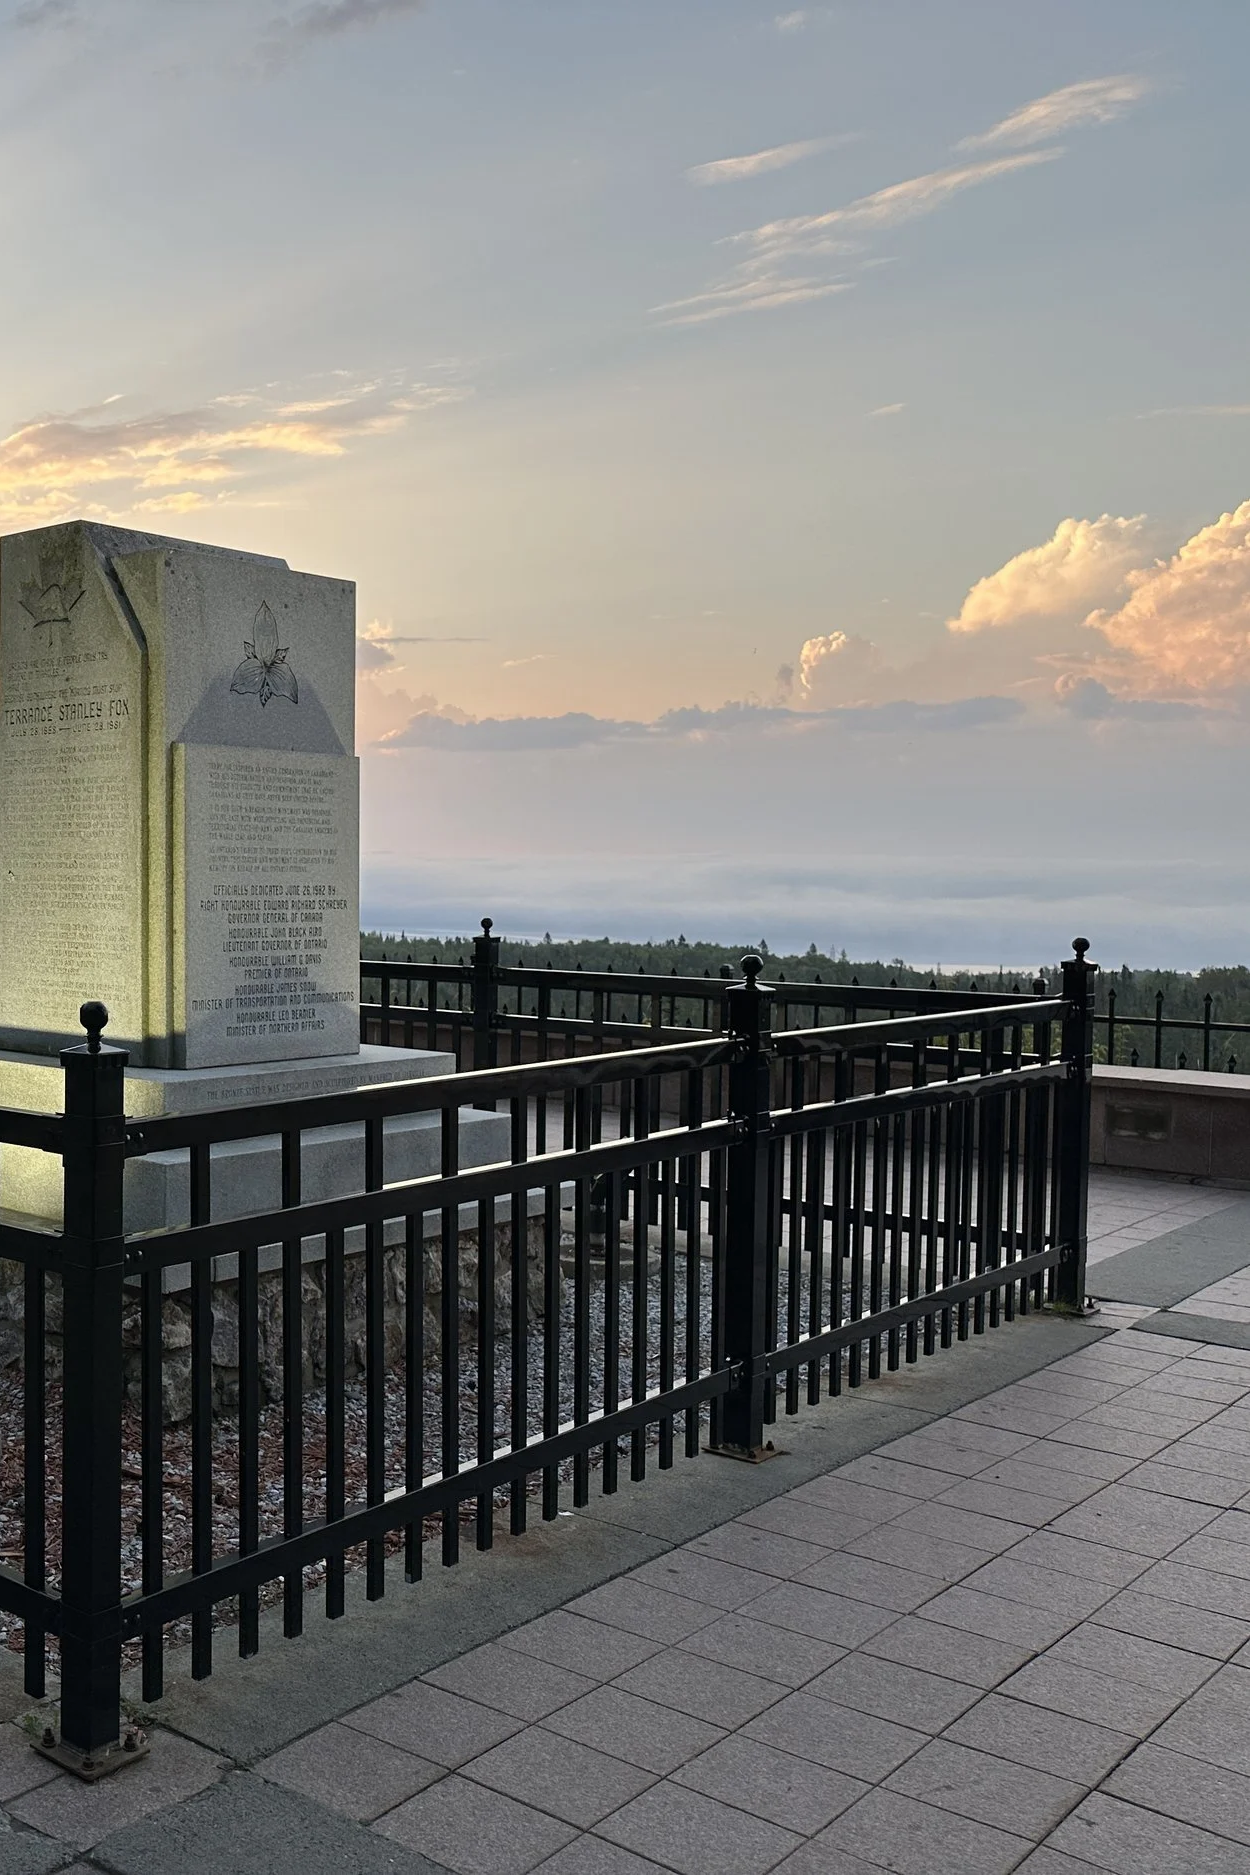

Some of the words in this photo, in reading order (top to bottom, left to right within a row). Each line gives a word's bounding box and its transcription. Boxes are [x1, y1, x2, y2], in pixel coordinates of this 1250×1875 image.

[4, 705, 52, 726] TERRANCE
[58, 702, 102, 721] STANLEY
[109, 698, 129, 717] FOX
[213, 884, 248, 896] OFFICIALLY
[250, 884, 284, 896] DEDICATED
[285, 884, 300, 896] JUNE
[328, 884, 336, 896] BY
[200, 900, 218, 912] RIGHT
[221, 900, 261, 912] HONOURABLE
[264, 900, 288, 911] EDWARD
[291, 900, 316, 910] RICHARD
[318, 899, 348, 910] SCHREYER
[228, 912, 260, 924] GOVERNOR
[262, 912, 288, 924] GENERAL
[291, 912, 299, 923] OF
[300, 912, 324, 922] CANADA
[228, 927, 269, 939] HONOURABLE
[270, 926, 286, 938] JOHN
[288, 926, 306, 938] BLACK
[308, 926, 322, 937] AIRD
[222, 941, 260, 952] LIEUTENANT
[262, 941, 292, 952] GOVERNOR
[294, 940, 302, 950] OF
[304, 940, 328, 950] ONTARIO
[229, 956, 269, 968] HONOURABLE
[270, 954, 296, 966] WILLIAM
[305, 954, 322, 964] DAVIS
[244, 968, 272, 980] PREMIER
[274, 968, 282, 979] OF
[284, 967, 308, 978] ONTARIO
[235, 984, 274, 996] HONOURABLE
[276, 982, 298, 994] JAMES
[300, 981, 316, 992] SNOW
[192, 998, 222, 1012] MINISTER
[225, 998, 234, 1010] OF
[236, 995, 287, 1009] TRANSPORTATION
[290, 994, 300, 1006] AND
[303, 992, 354, 1004] COMMUNICATIONS
[236, 1010, 276, 1024] HONOURABLE
[278, 1010, 290, 1021] LEO
[292, 1008, 316, 1020] BERNIER
[226, 1024, 256, 1038] MINISTER
[258, 1024, 266, 1036] OF
[268, 1021, 300, 1034] NORTHERN
[302, 1020, 325, 1032] AFFAIRS
[206, 1091, 218, 1100] THE
[269, 1084, 280, 1093] WAS
